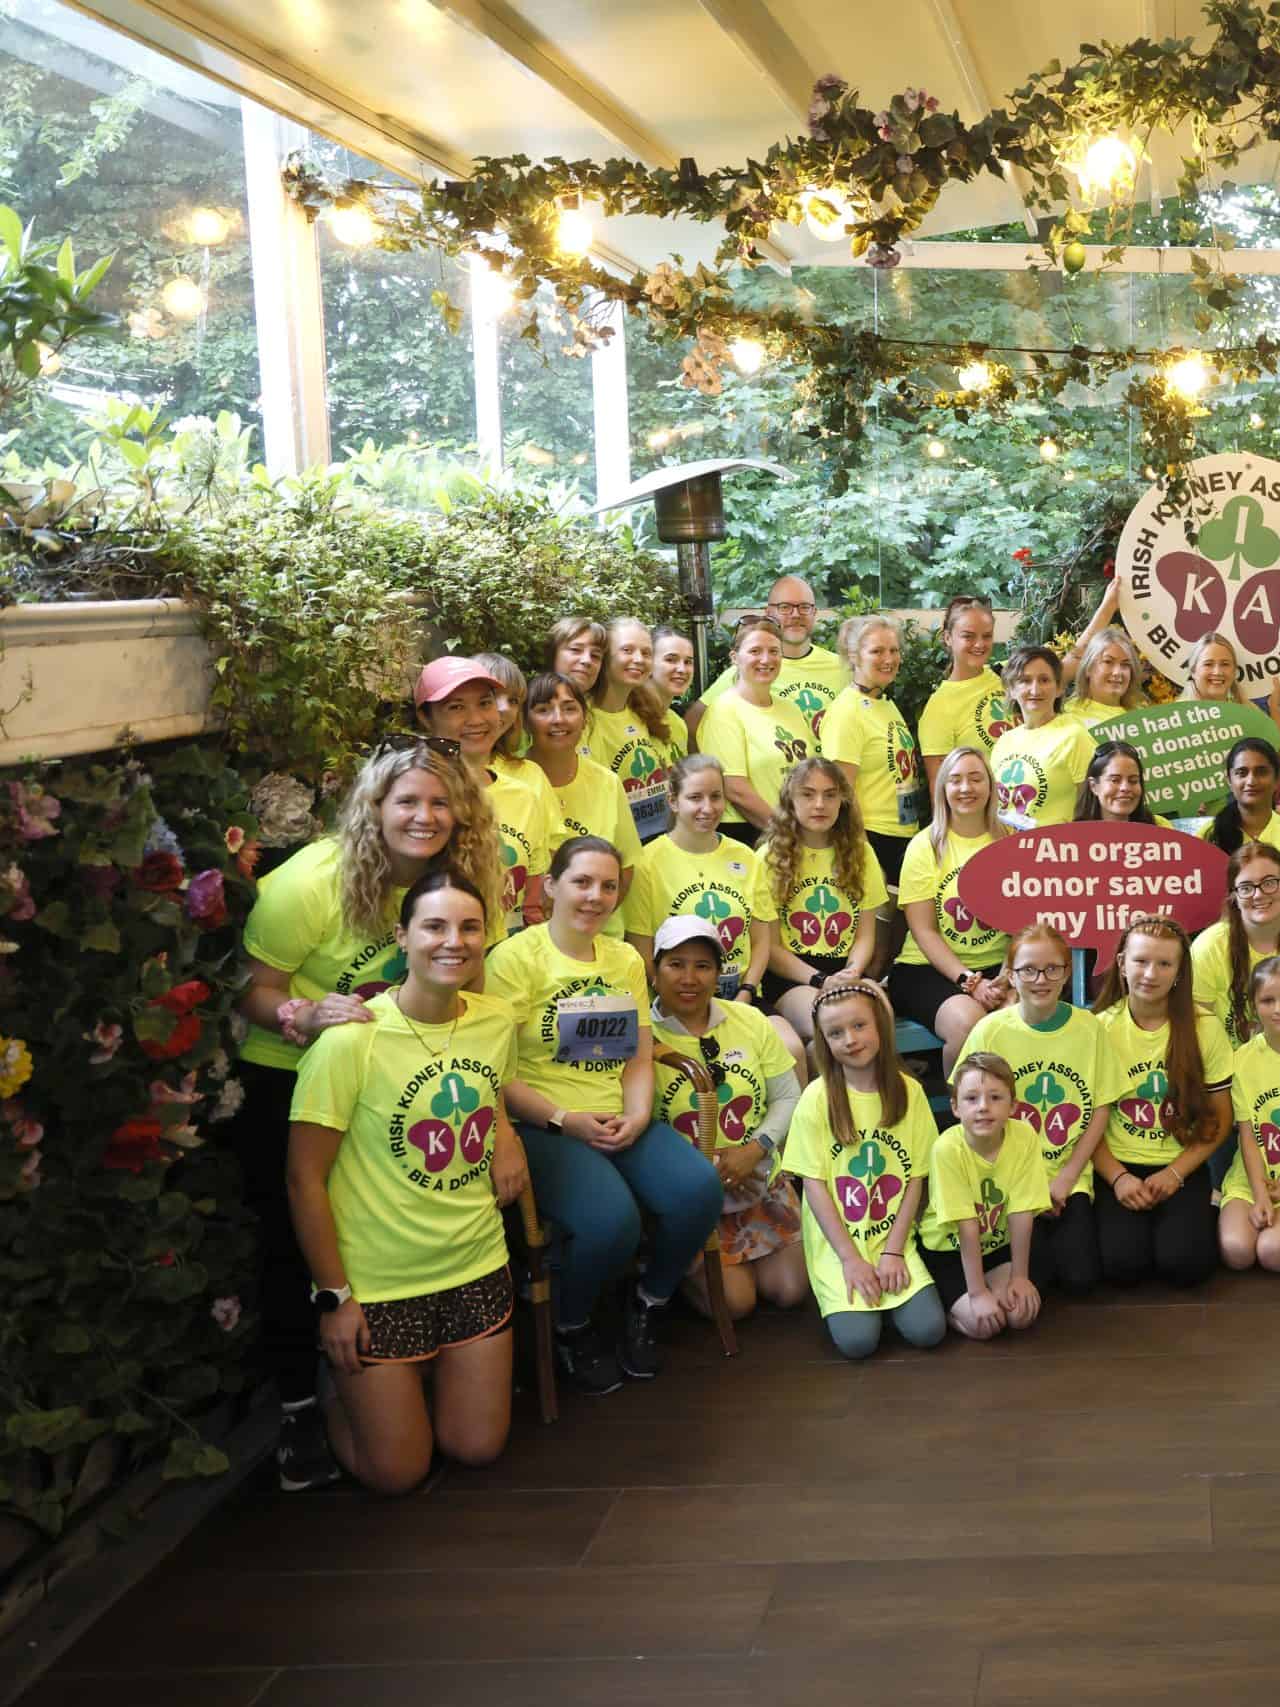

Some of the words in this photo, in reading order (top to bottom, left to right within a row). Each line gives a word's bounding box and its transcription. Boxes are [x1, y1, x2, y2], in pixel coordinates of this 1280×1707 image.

[1131, 528, 1159, 600] IRISH
[1147, 624, 1181, 660] BE
[1142, 711, 1183, 734] had
[1186, 706, 1221, 724] the
[1152, 723, 1243, 755] donation
[610, 740, 635, 774] KIDNEY
[1088, 841, 1182, 869] organ
[671, 882, 705, 910] KIDNEY
[1001, 872, 1099, 898] donor
[1108, 869, 1203, 897] saved
[944, 928, 959, 941] BE
[971, 929, 997, 946] DONO
[1036, 909, 1088, 939] my
[351, 932, 395, 971] KIDNE
[541, 1004, 558, 1042] IRISH
[576, 1017, 627, 1038] 40122
[389, 1113, 407, 1158] IRISH
[398, 1060, 445, 1110] KIDNEY
[1048, 1062, 1093, 1130] ASSOCIATION
[407, 1168, 431, 1189] BE
[433, 1179, 444, 1192] A
[450, 1150, 494, 1190] DONOR
